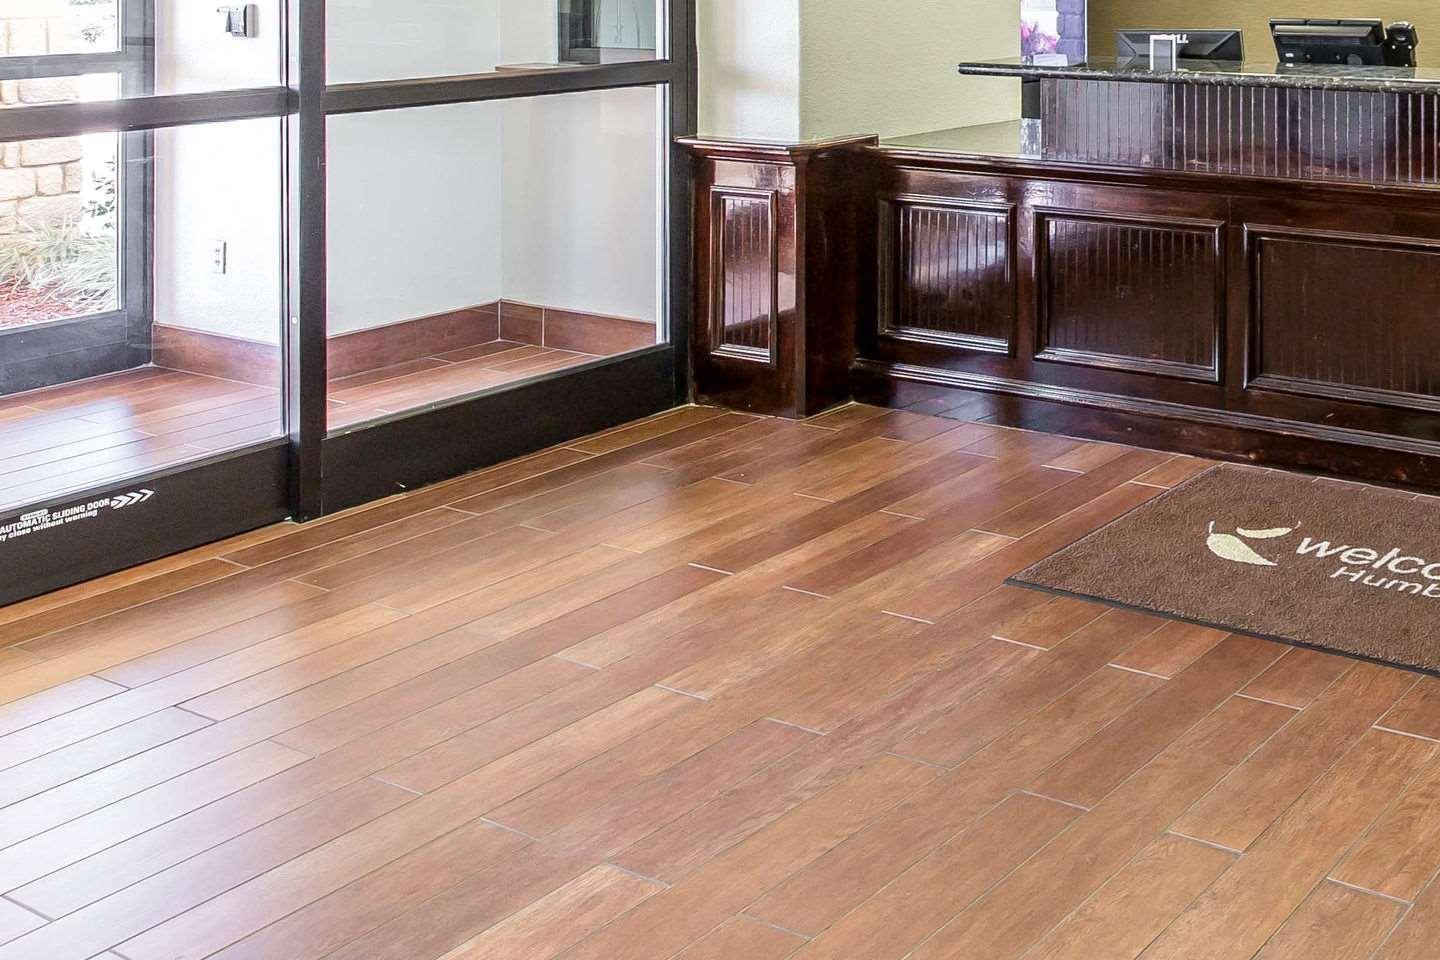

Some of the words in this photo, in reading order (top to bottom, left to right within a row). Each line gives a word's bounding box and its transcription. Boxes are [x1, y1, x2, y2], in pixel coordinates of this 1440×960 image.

[0, 514, 51, 535] AUTOMATIC
[51, 505, 85, 520] SLIDING
[86, 498, 110, 510] DOOR
[8, 528, 31, 539] close
[32, 519, 64, 532] without
[65, 509, 98, 523] warning
